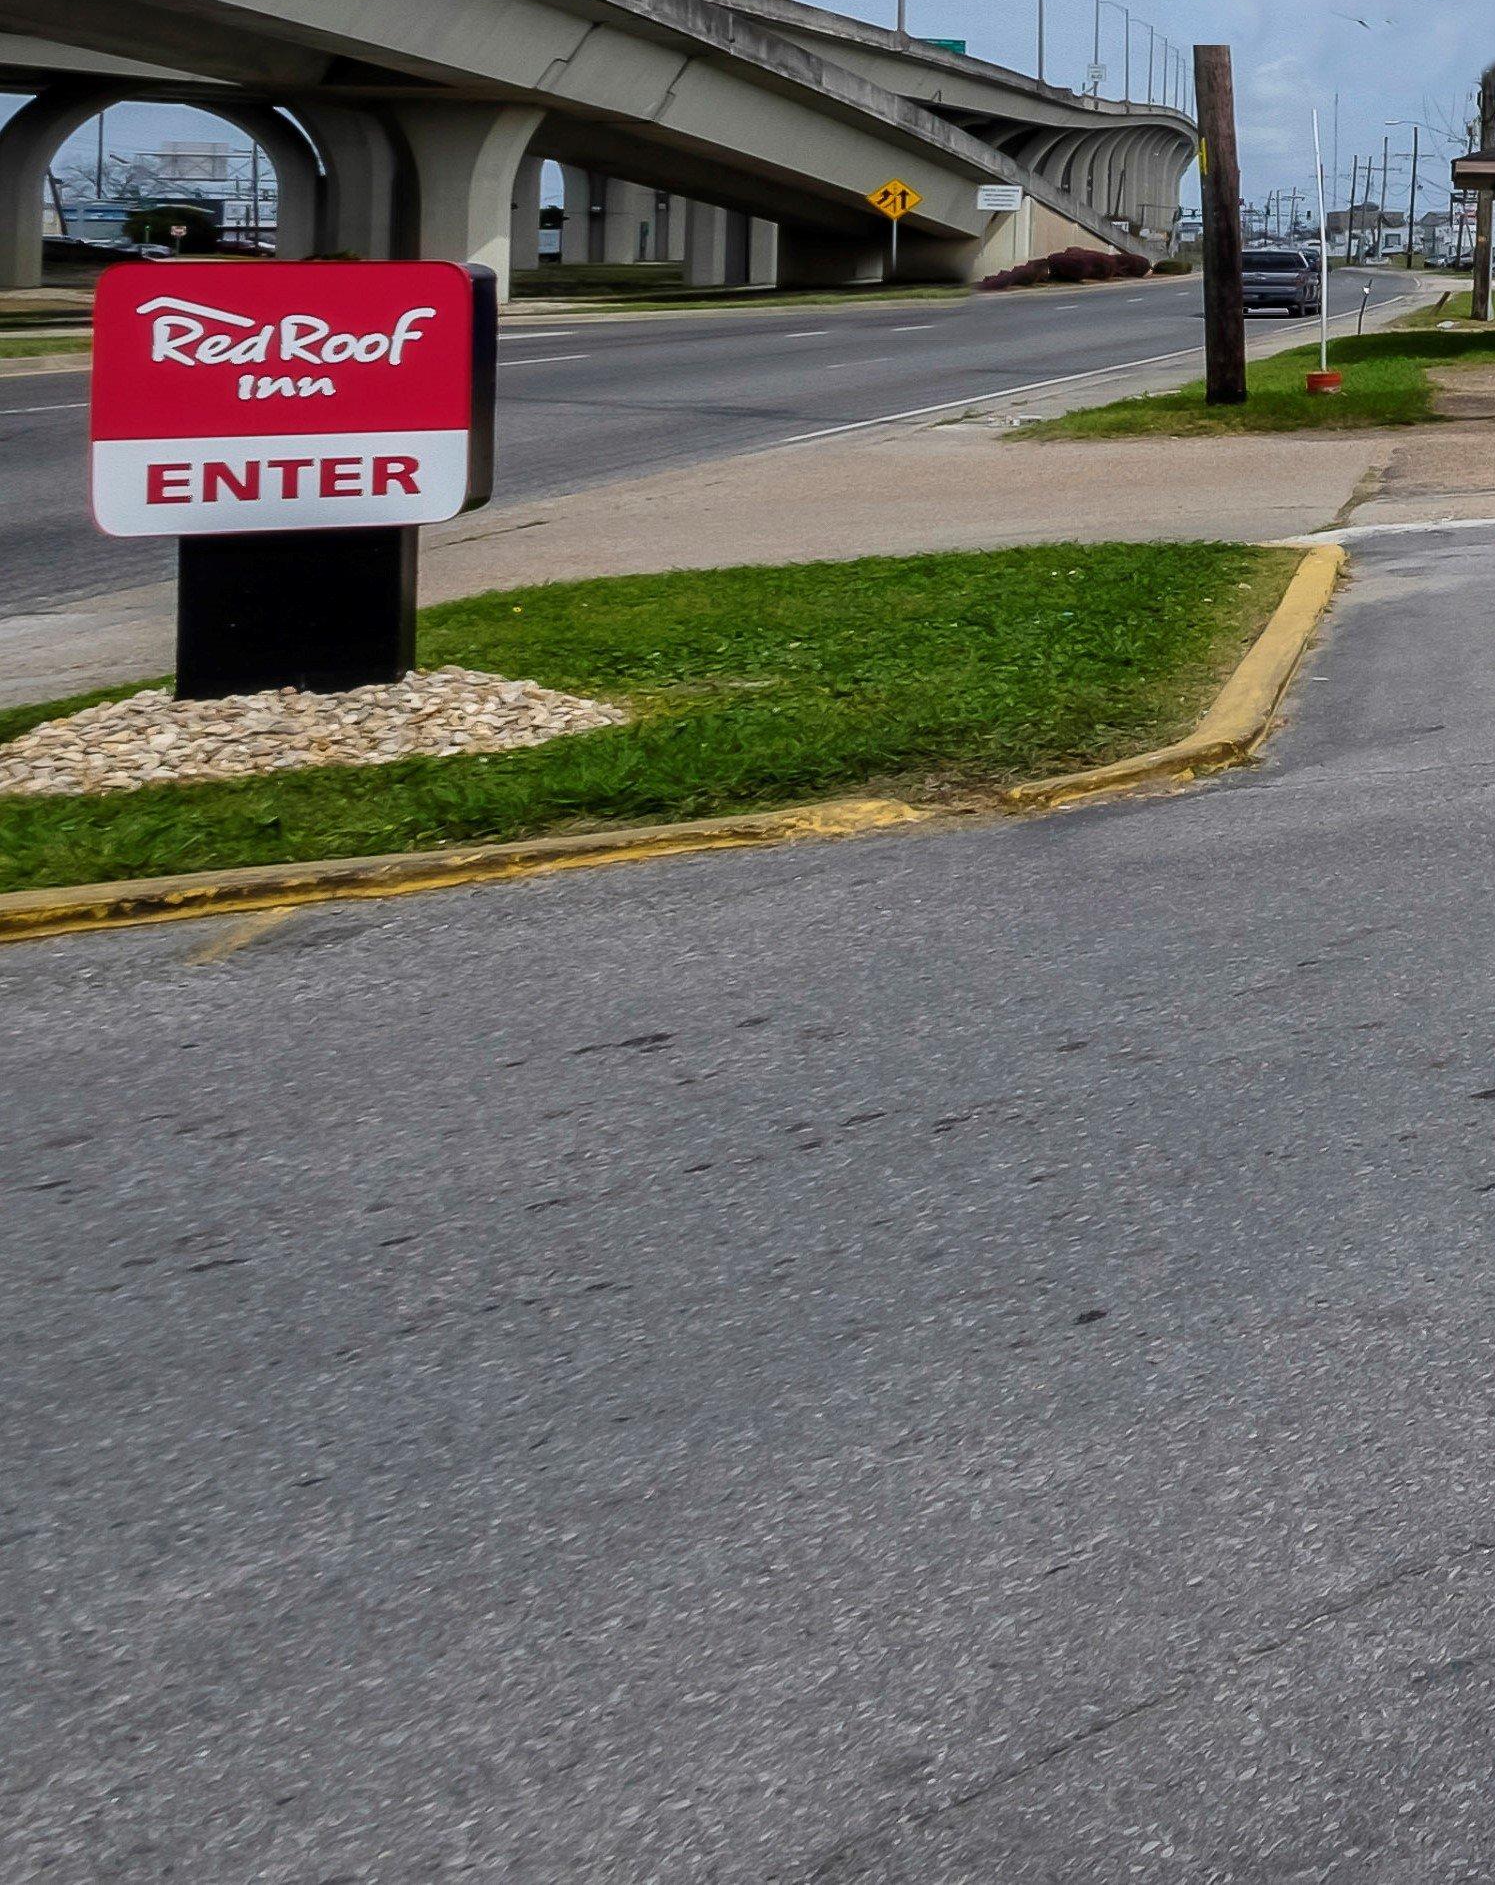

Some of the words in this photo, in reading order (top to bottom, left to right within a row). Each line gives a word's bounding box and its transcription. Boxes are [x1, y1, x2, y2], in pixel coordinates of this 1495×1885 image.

[151, 314, 277, 366] Red
[279, 307, 437, 366] Roof
[237, 374, 338, 400] Inn
[146, 454, 421, 505] ENTER
